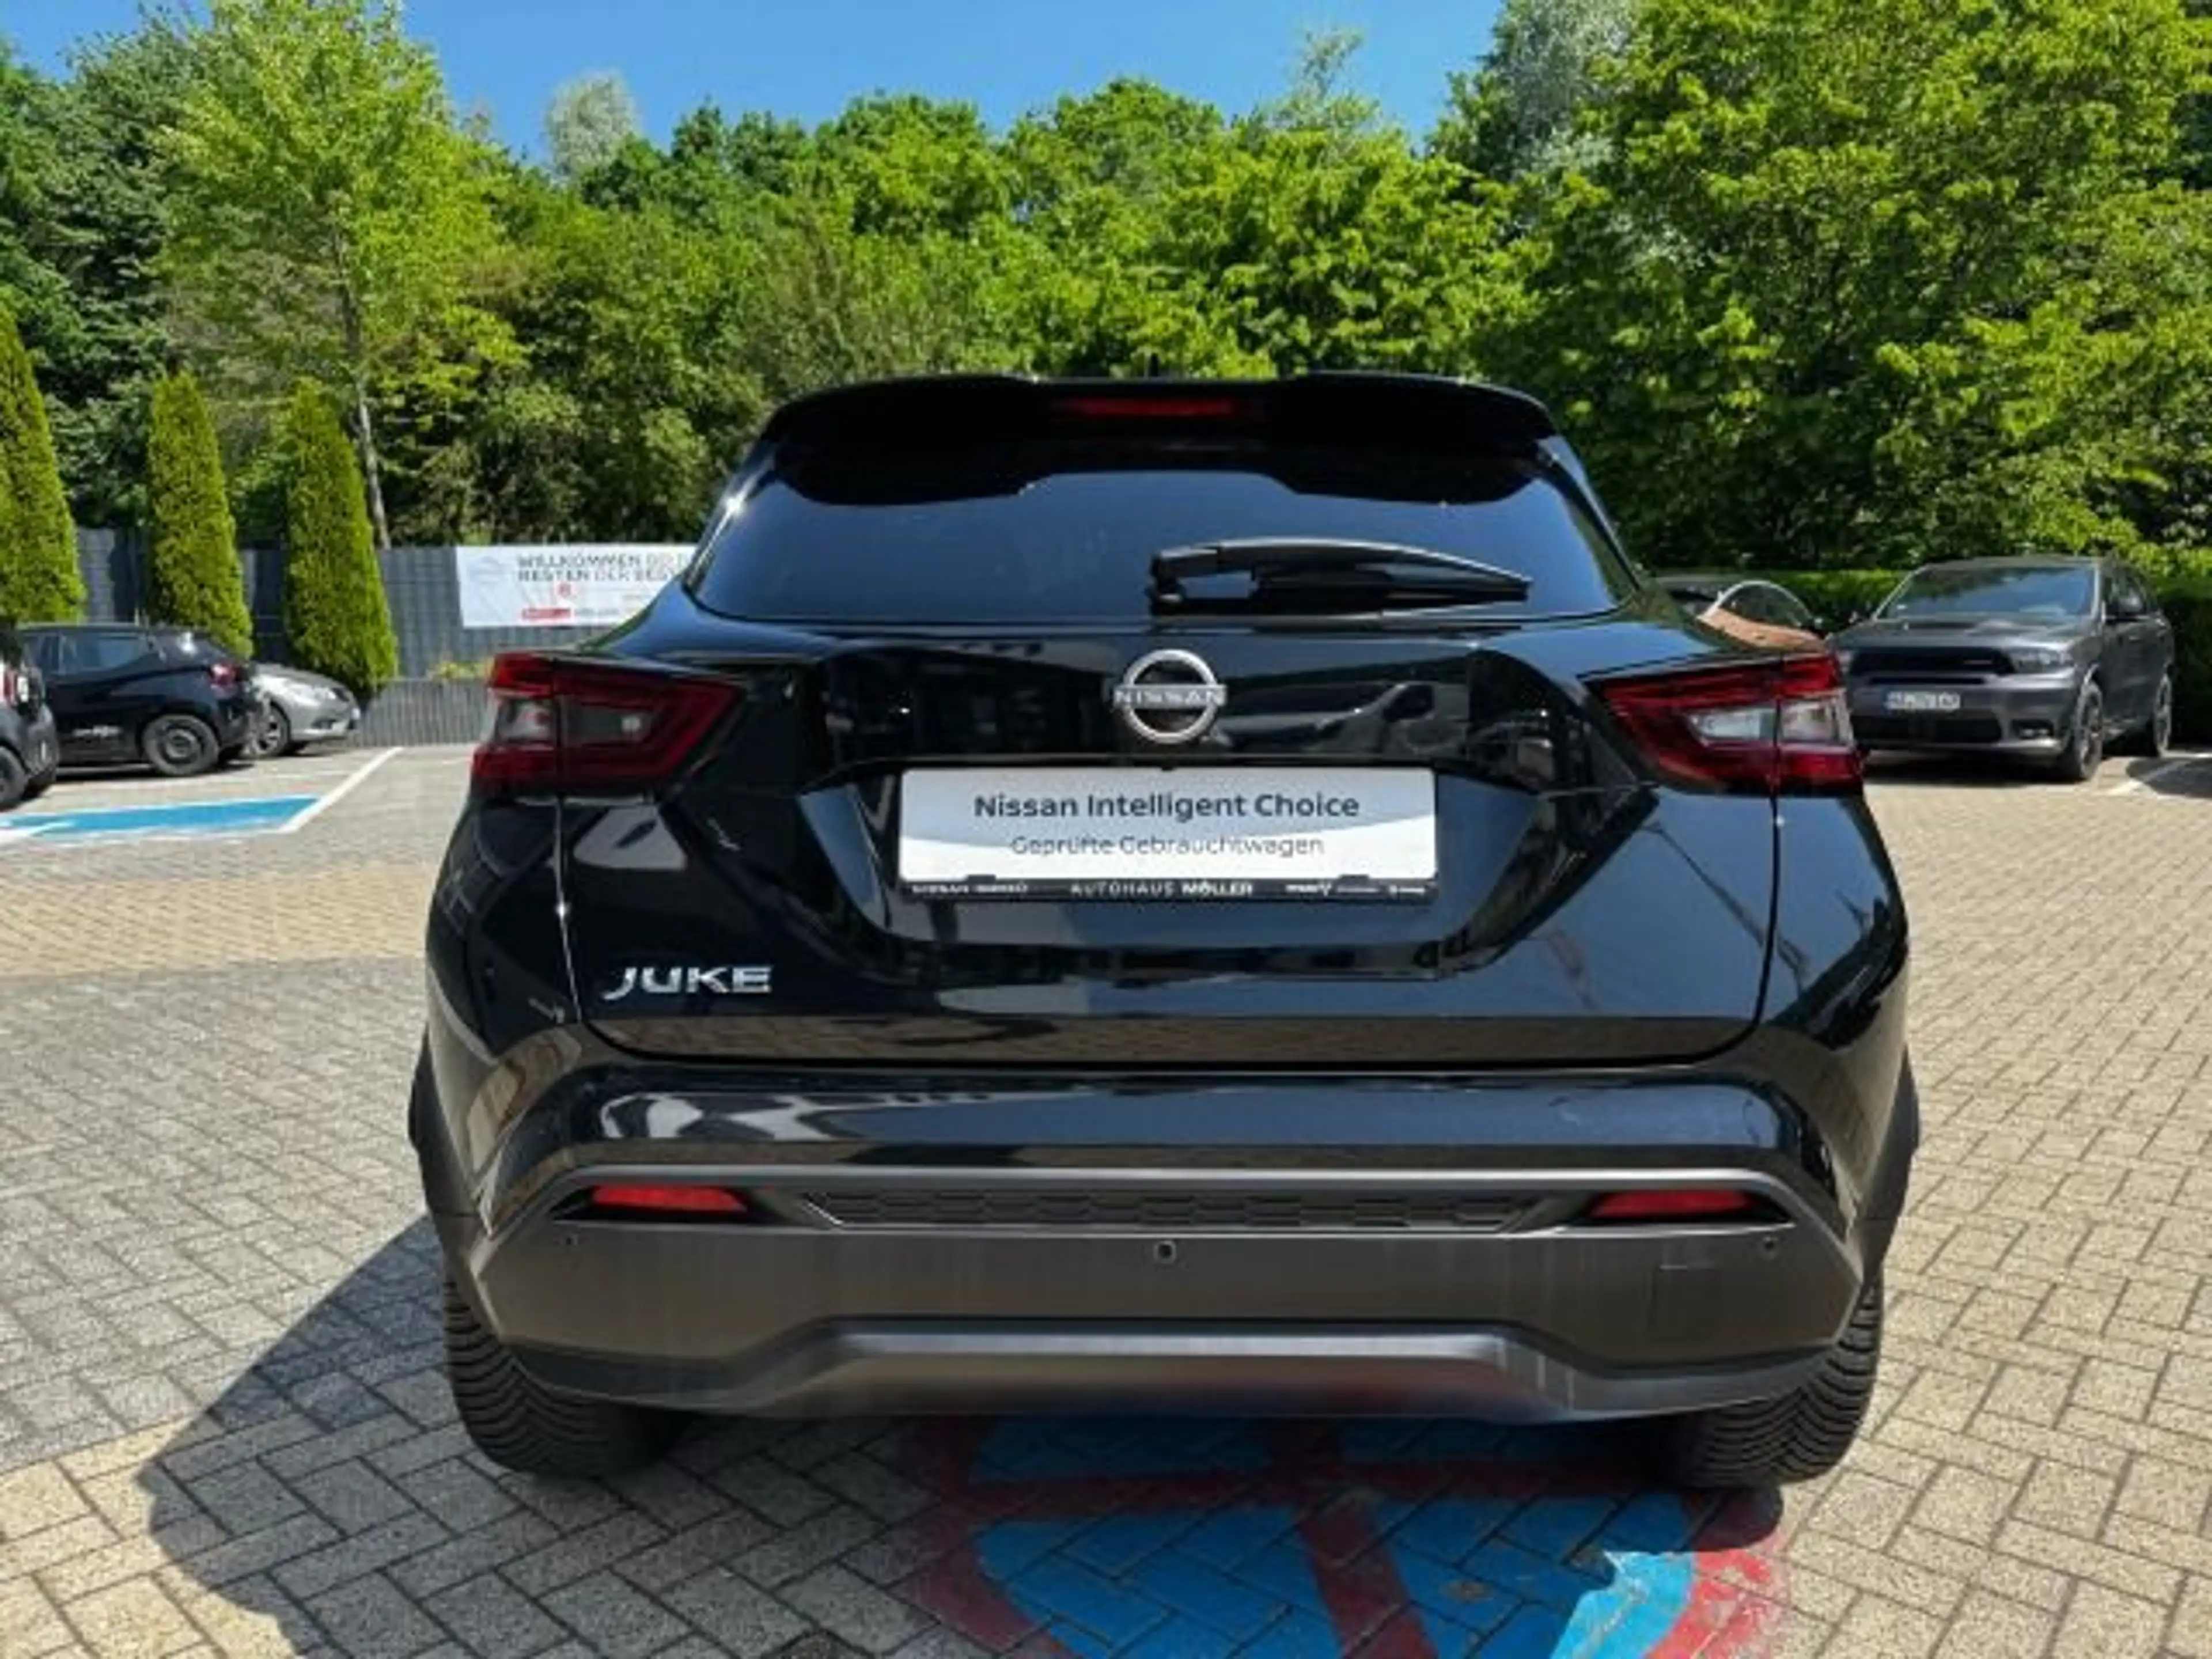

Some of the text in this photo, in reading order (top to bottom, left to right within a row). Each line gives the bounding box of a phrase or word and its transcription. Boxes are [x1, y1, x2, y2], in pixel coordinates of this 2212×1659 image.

[518, 553, 640, 567] WILLKOMMEN
[1113, 690, 1225, 705] NISSAN
[974, 791, 1359, 823] Nissan Intelligent Choice
[1012, 835, 1325, 857] Geprüfte Gebrauchtwagen
[1070, 881, 1253, 897] AUTOHAUS MÖLLER
[602, 966, 774, 1001] JUKE
